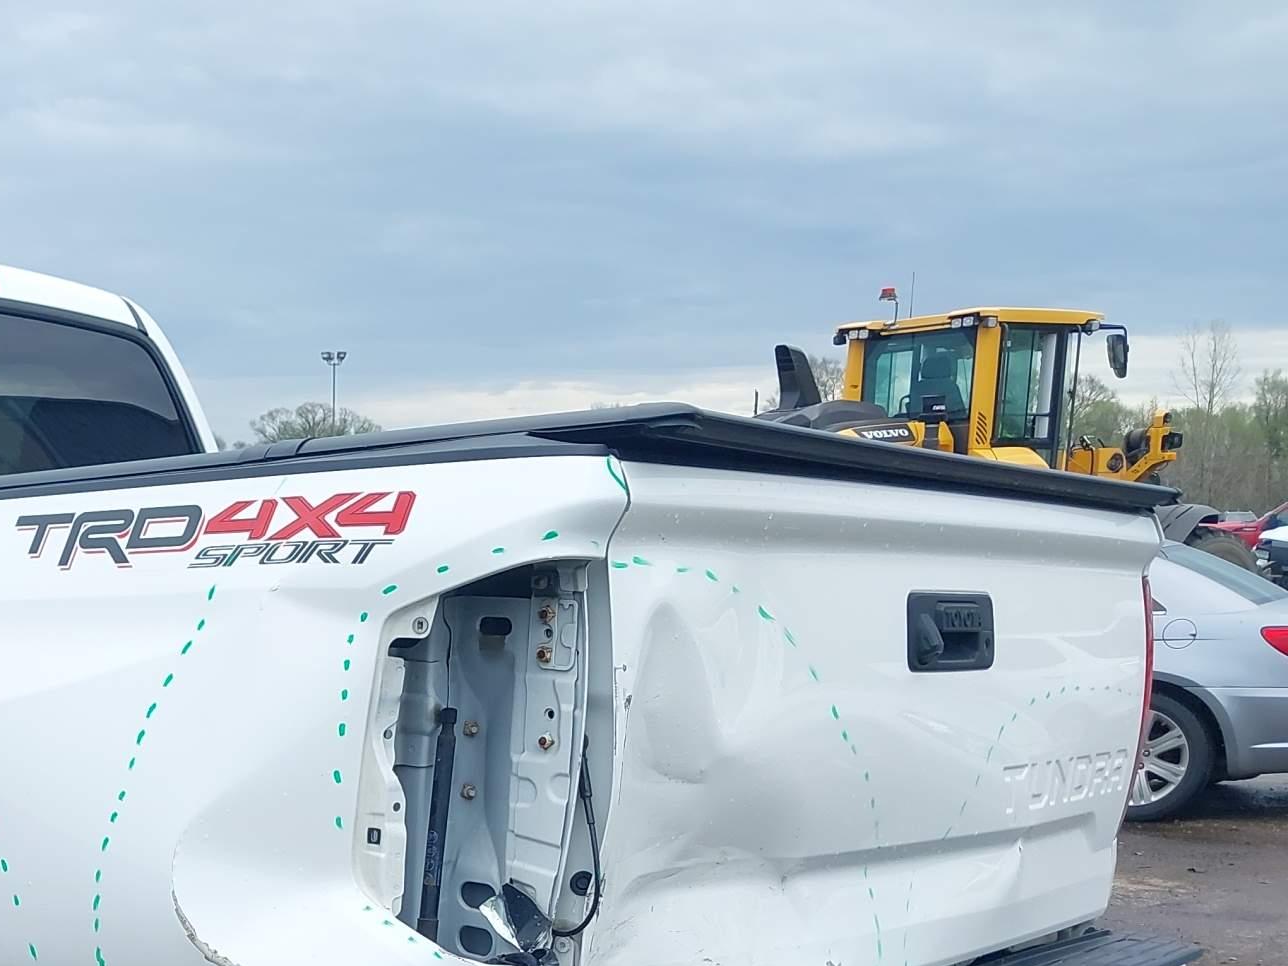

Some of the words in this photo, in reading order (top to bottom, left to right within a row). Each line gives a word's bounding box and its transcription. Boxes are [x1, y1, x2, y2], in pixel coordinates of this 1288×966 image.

[861, 428, 910, 440] VOLVO
[16, 505, 204, 571] TRD
[187, 538, 395, 569] SPORT
[1001, 748, 1129, 815] TUNDRA
